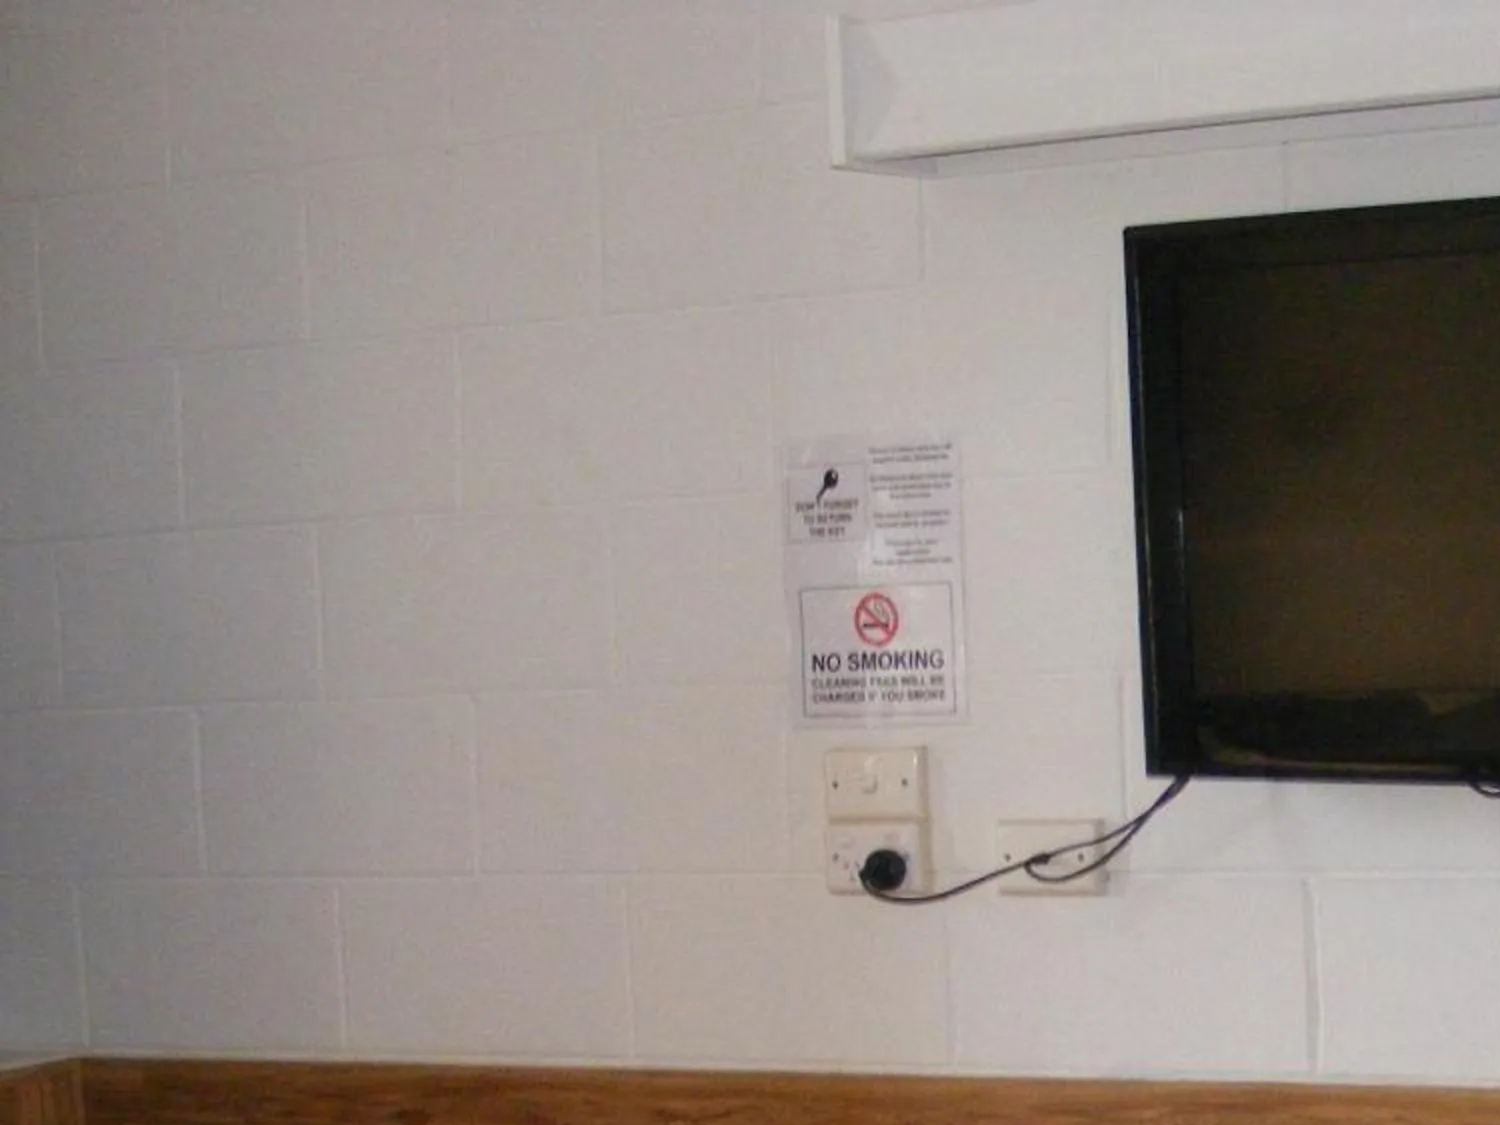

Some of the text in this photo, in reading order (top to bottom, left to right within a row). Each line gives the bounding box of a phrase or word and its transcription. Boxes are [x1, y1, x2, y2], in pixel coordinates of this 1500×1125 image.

[812, 648, 945, 673] NO SMOKING
[811, 677, 867, 689] CLEANING
[900, 675, 925, 686] WILL
[881, 690, 904, 701] YOU
[907, 689, 945, 700] SMOKE
